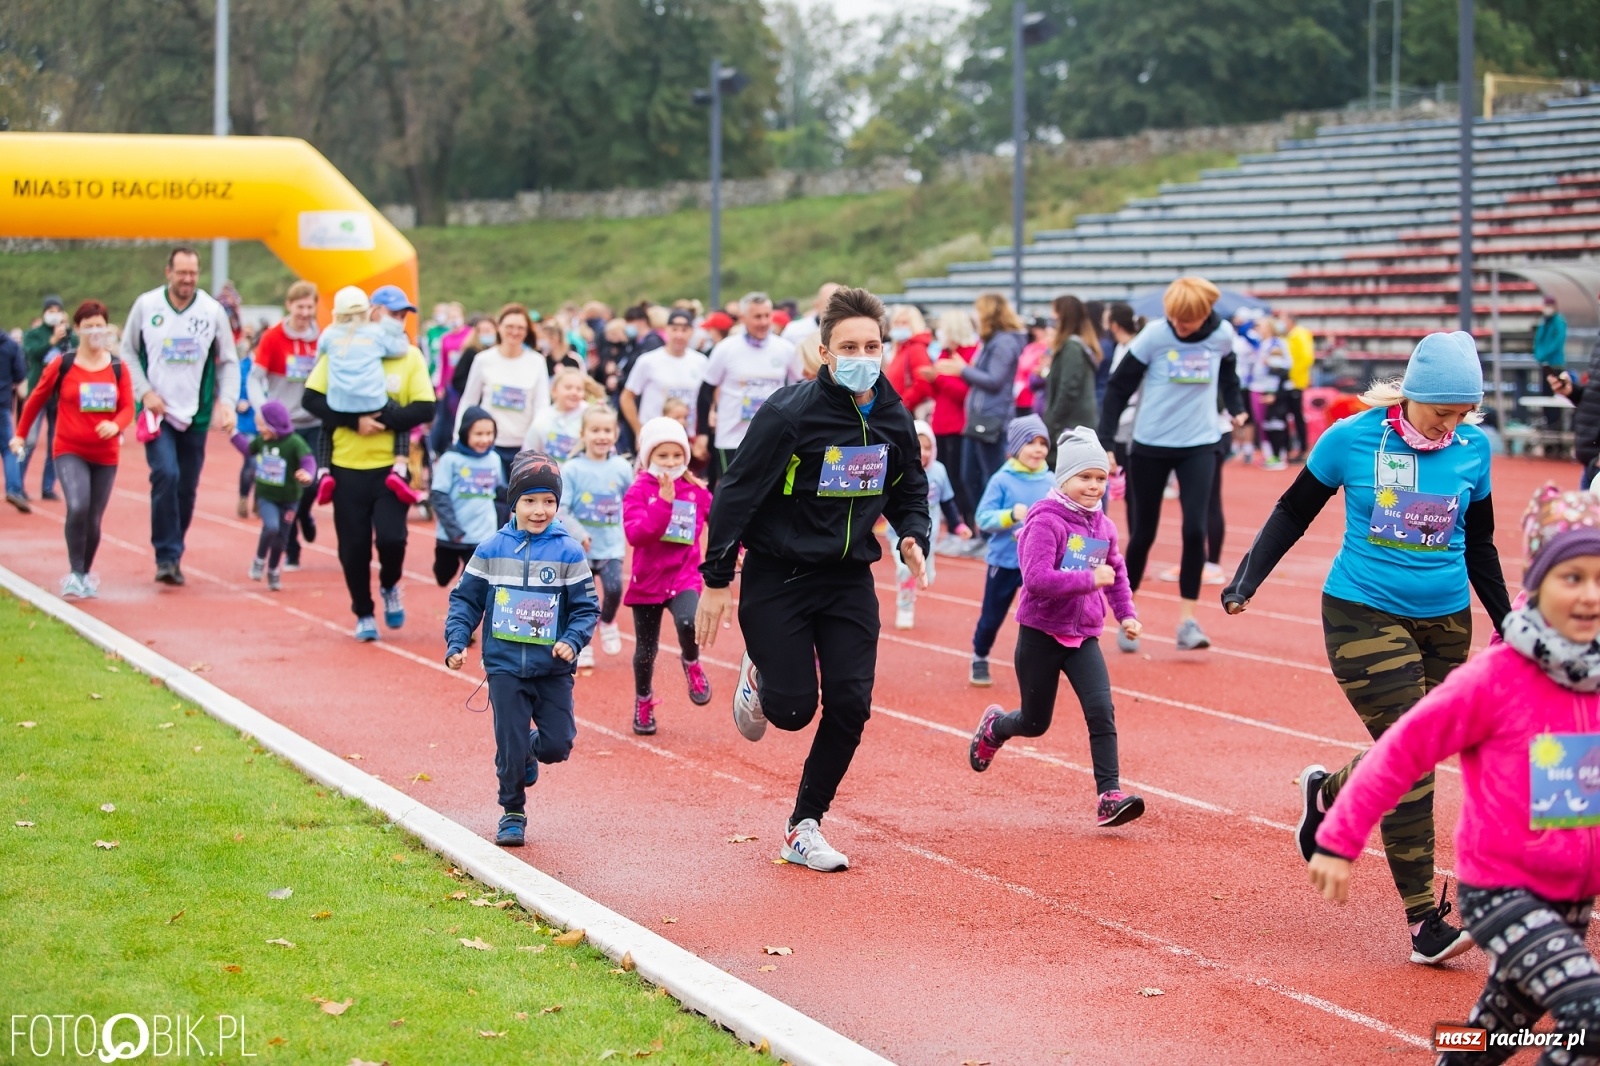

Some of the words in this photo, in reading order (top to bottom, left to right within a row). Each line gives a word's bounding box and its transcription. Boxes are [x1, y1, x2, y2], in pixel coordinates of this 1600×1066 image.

[13, 178, 104, 199] MIASTO
[111, 177, 234, 200] RACIBÓRZ
[859, 479, 879, 489] 015
[1384, 509, 1402, 518] BIEG
[1404, 512, 1420, 521] DLA
[1420, 531, 1445, 547] 186
[516, 608, 528, 616] DLA
